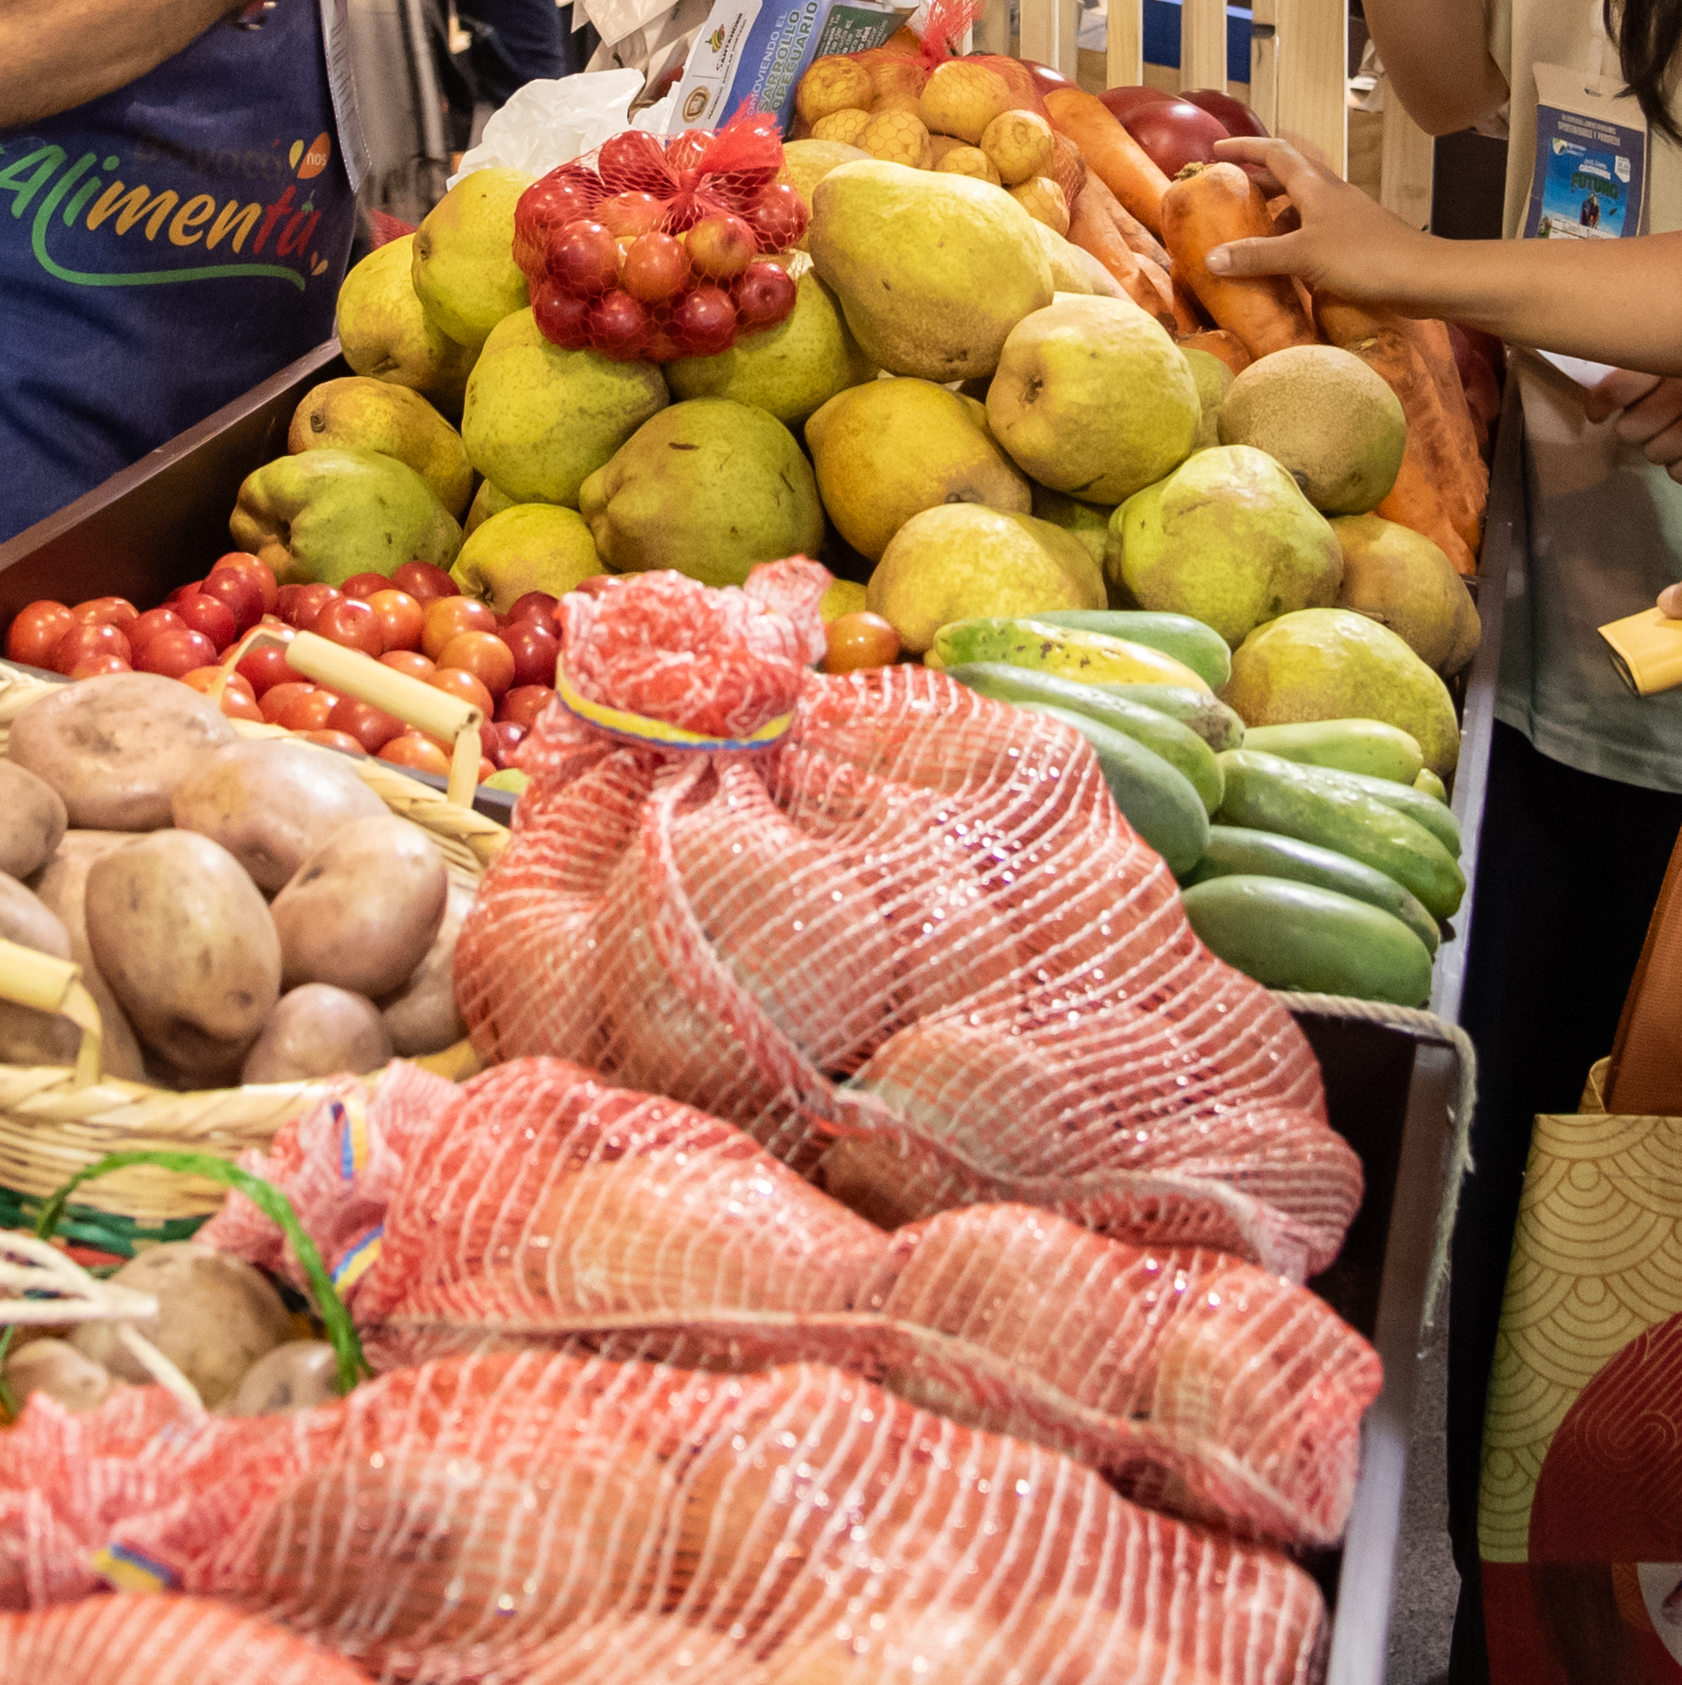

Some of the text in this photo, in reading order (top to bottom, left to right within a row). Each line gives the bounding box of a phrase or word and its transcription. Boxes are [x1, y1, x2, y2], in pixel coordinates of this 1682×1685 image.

[747, 12, 787, 116] OMOVIENDO EL
[760, 9, 801, 112] SARROLLO
[770, 0, 819, 112] OPECUARIO
[306, 152, 327, 167] nos
